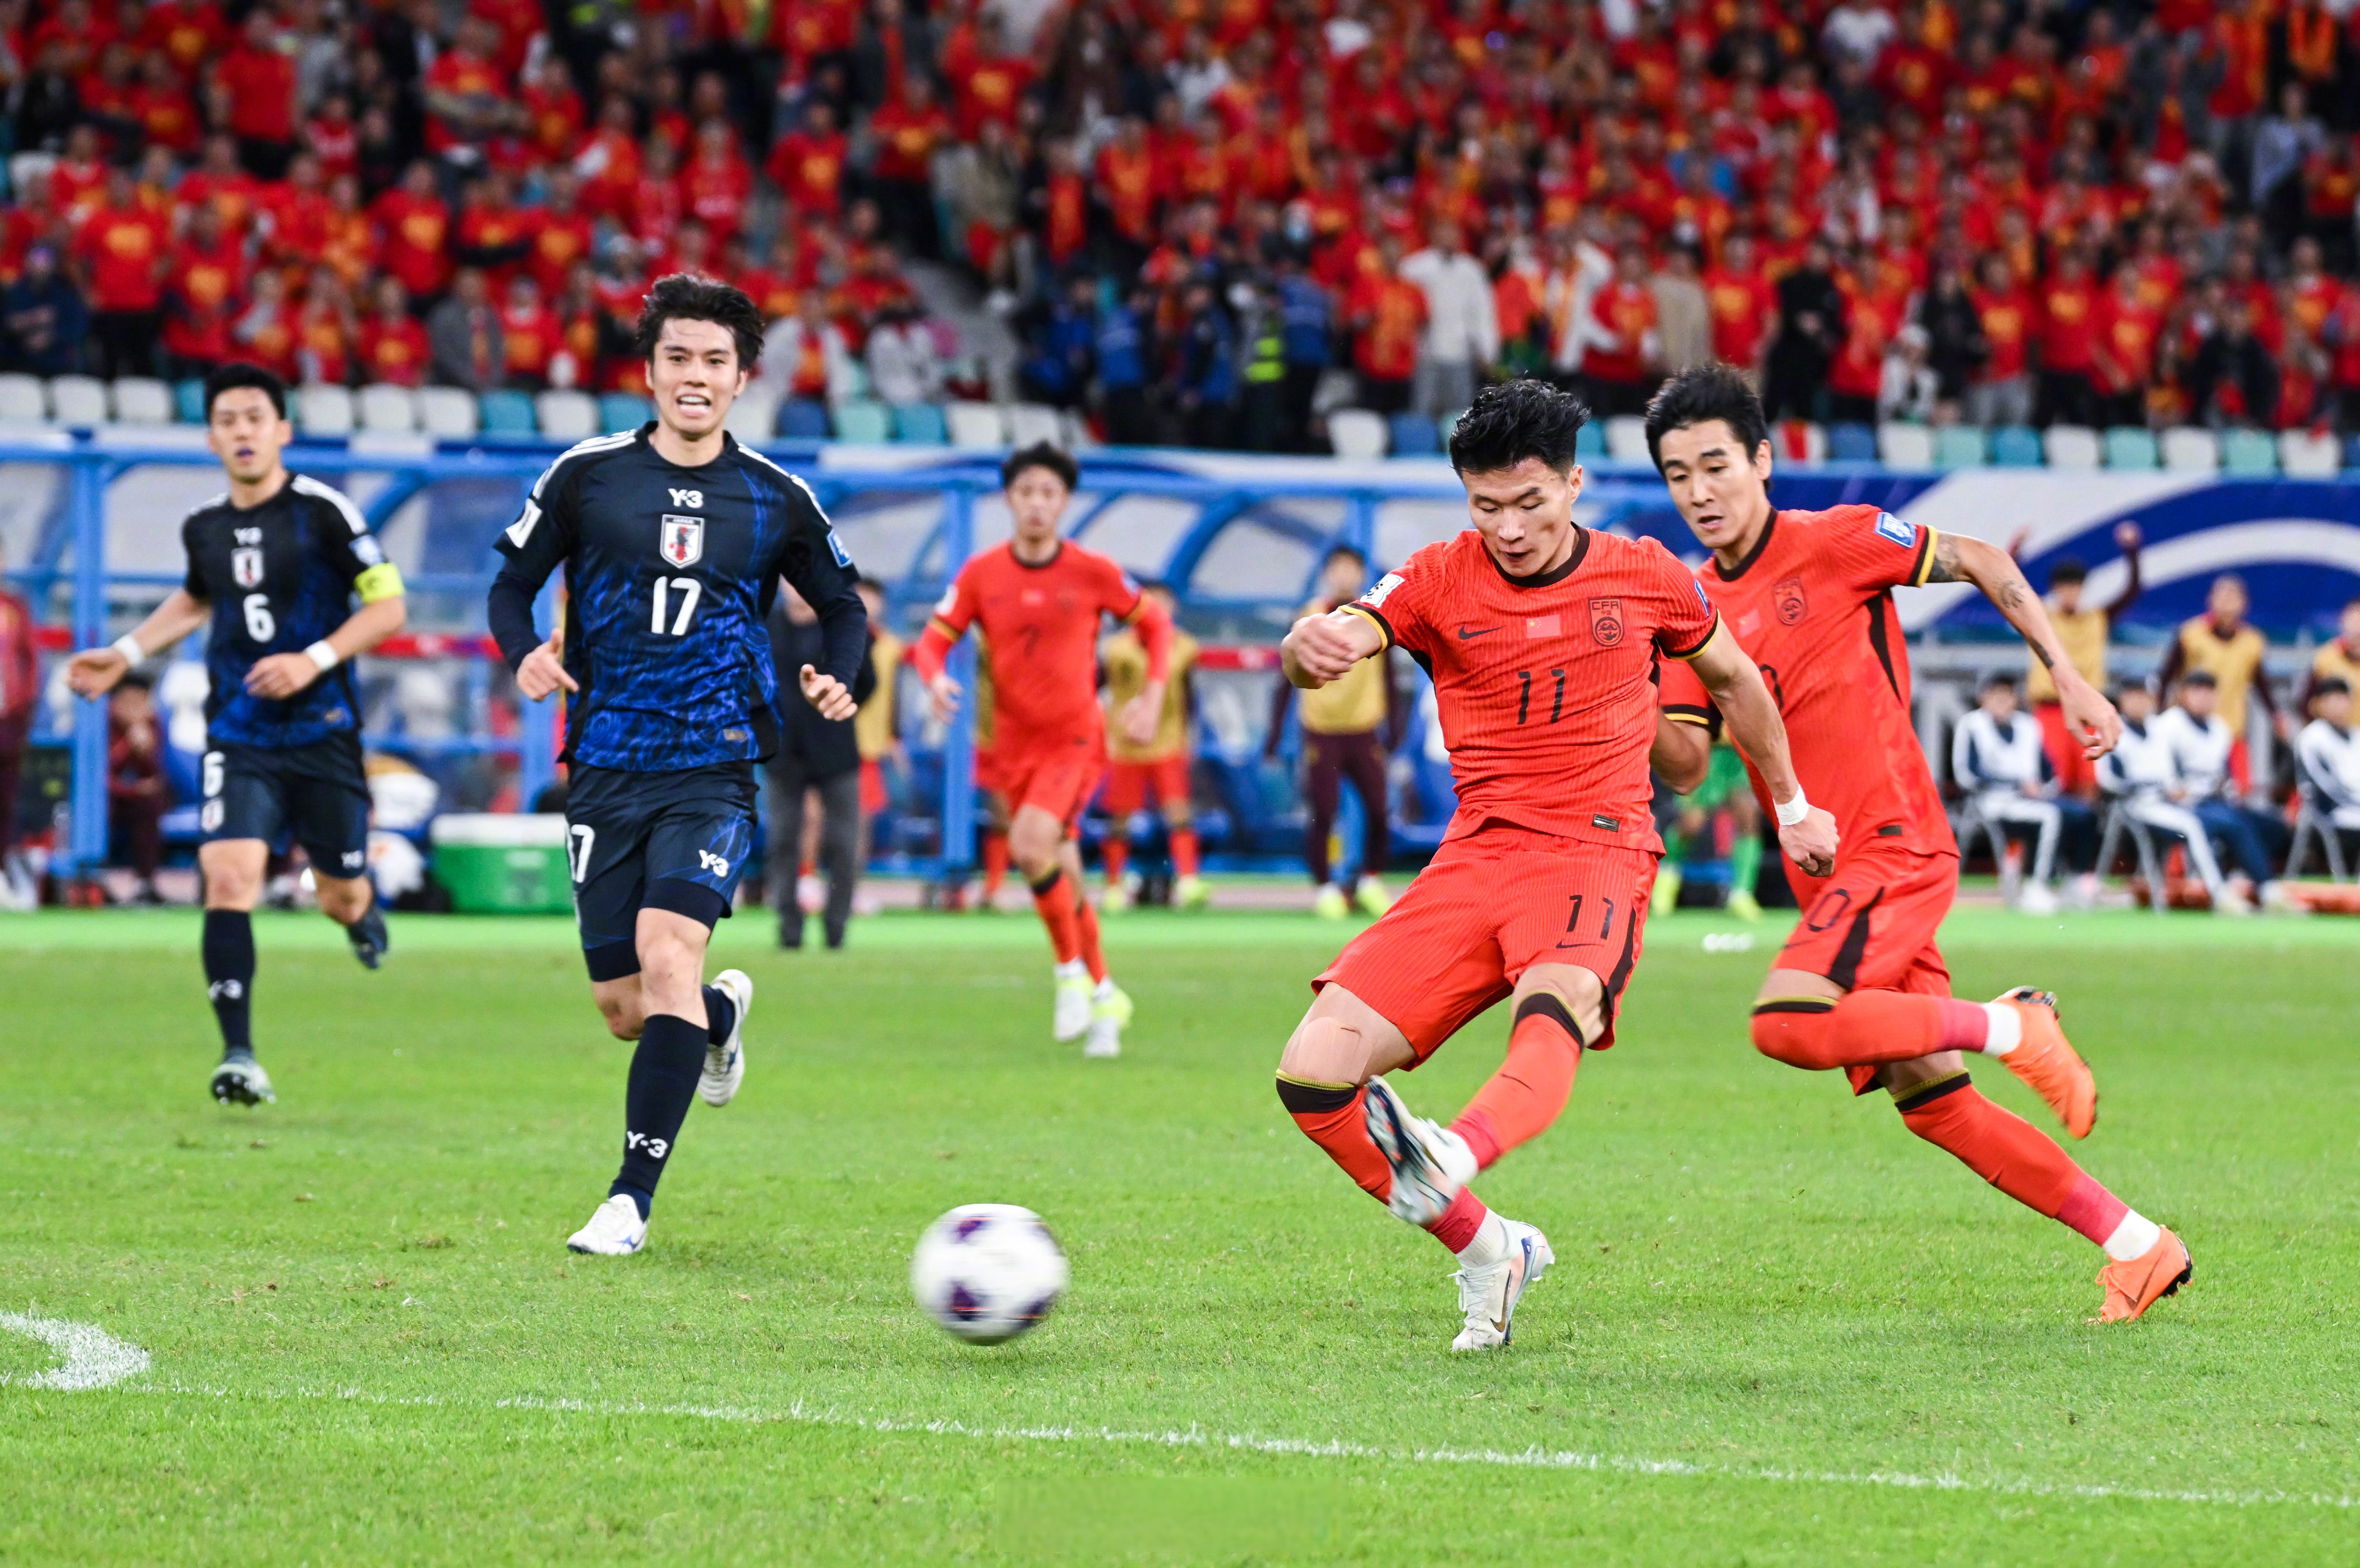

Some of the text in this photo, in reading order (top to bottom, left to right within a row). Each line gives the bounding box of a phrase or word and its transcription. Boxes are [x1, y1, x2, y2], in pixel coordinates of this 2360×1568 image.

[668, 488, 703, 509] Y-3
[243, 593, 277, 643] 6
[651, 576, 701, 635] 17
[1592, 601, 1619, 610] CFA
[1518, 669, 1565, 724] 11
[699, 849, 729, 877] Y-3
[1566, 895, 1614, 940] 11
[627, 1131, 668, 1159] Y-3
